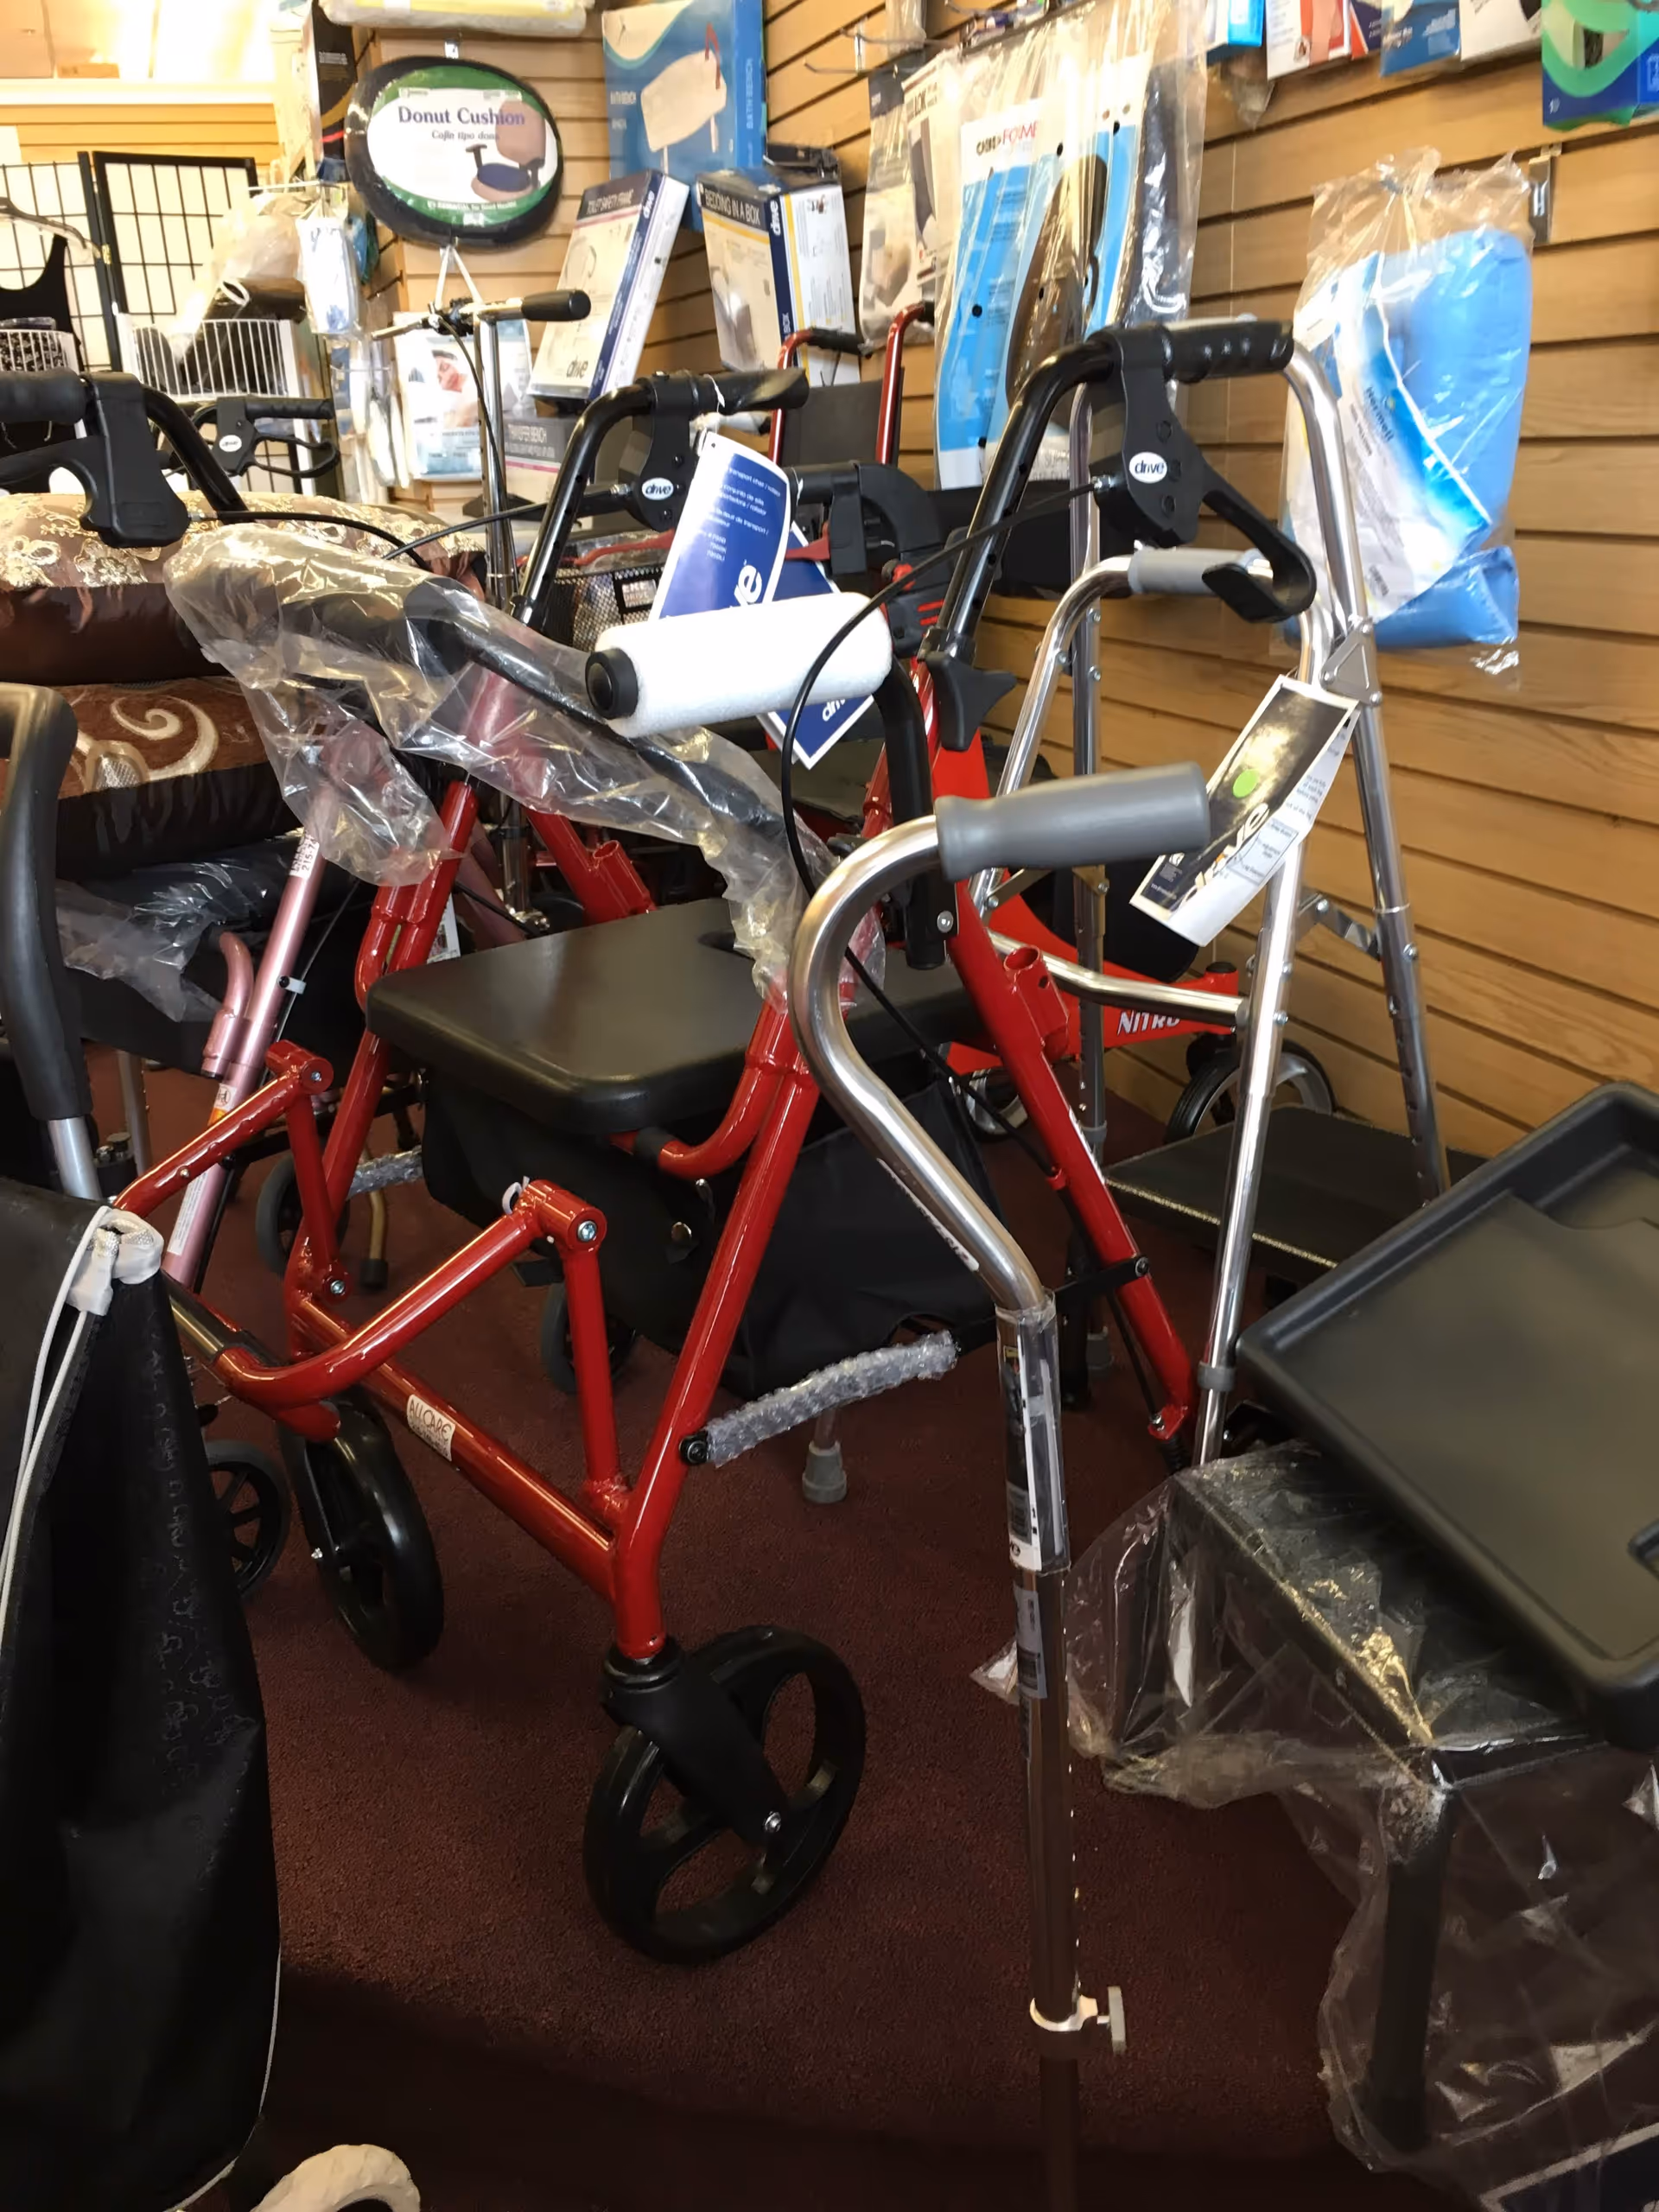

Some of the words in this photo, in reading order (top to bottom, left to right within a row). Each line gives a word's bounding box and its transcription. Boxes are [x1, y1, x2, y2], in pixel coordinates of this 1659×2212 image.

[397, 105, 451, 124] Donut
[457, 106, 525, 125] Cushion
[457, 130, 475, 142] tipo
[642, 191, 655, 219] drive
[704, 188, 731, 214] BEDDING
[740, 203, 746, 221] A
[746, 205, 761, 226] BOX
[770, 200, 782, 236] drive
[1135, 459, 1166, 474] drive
[645, 481, 672, 495] drive
